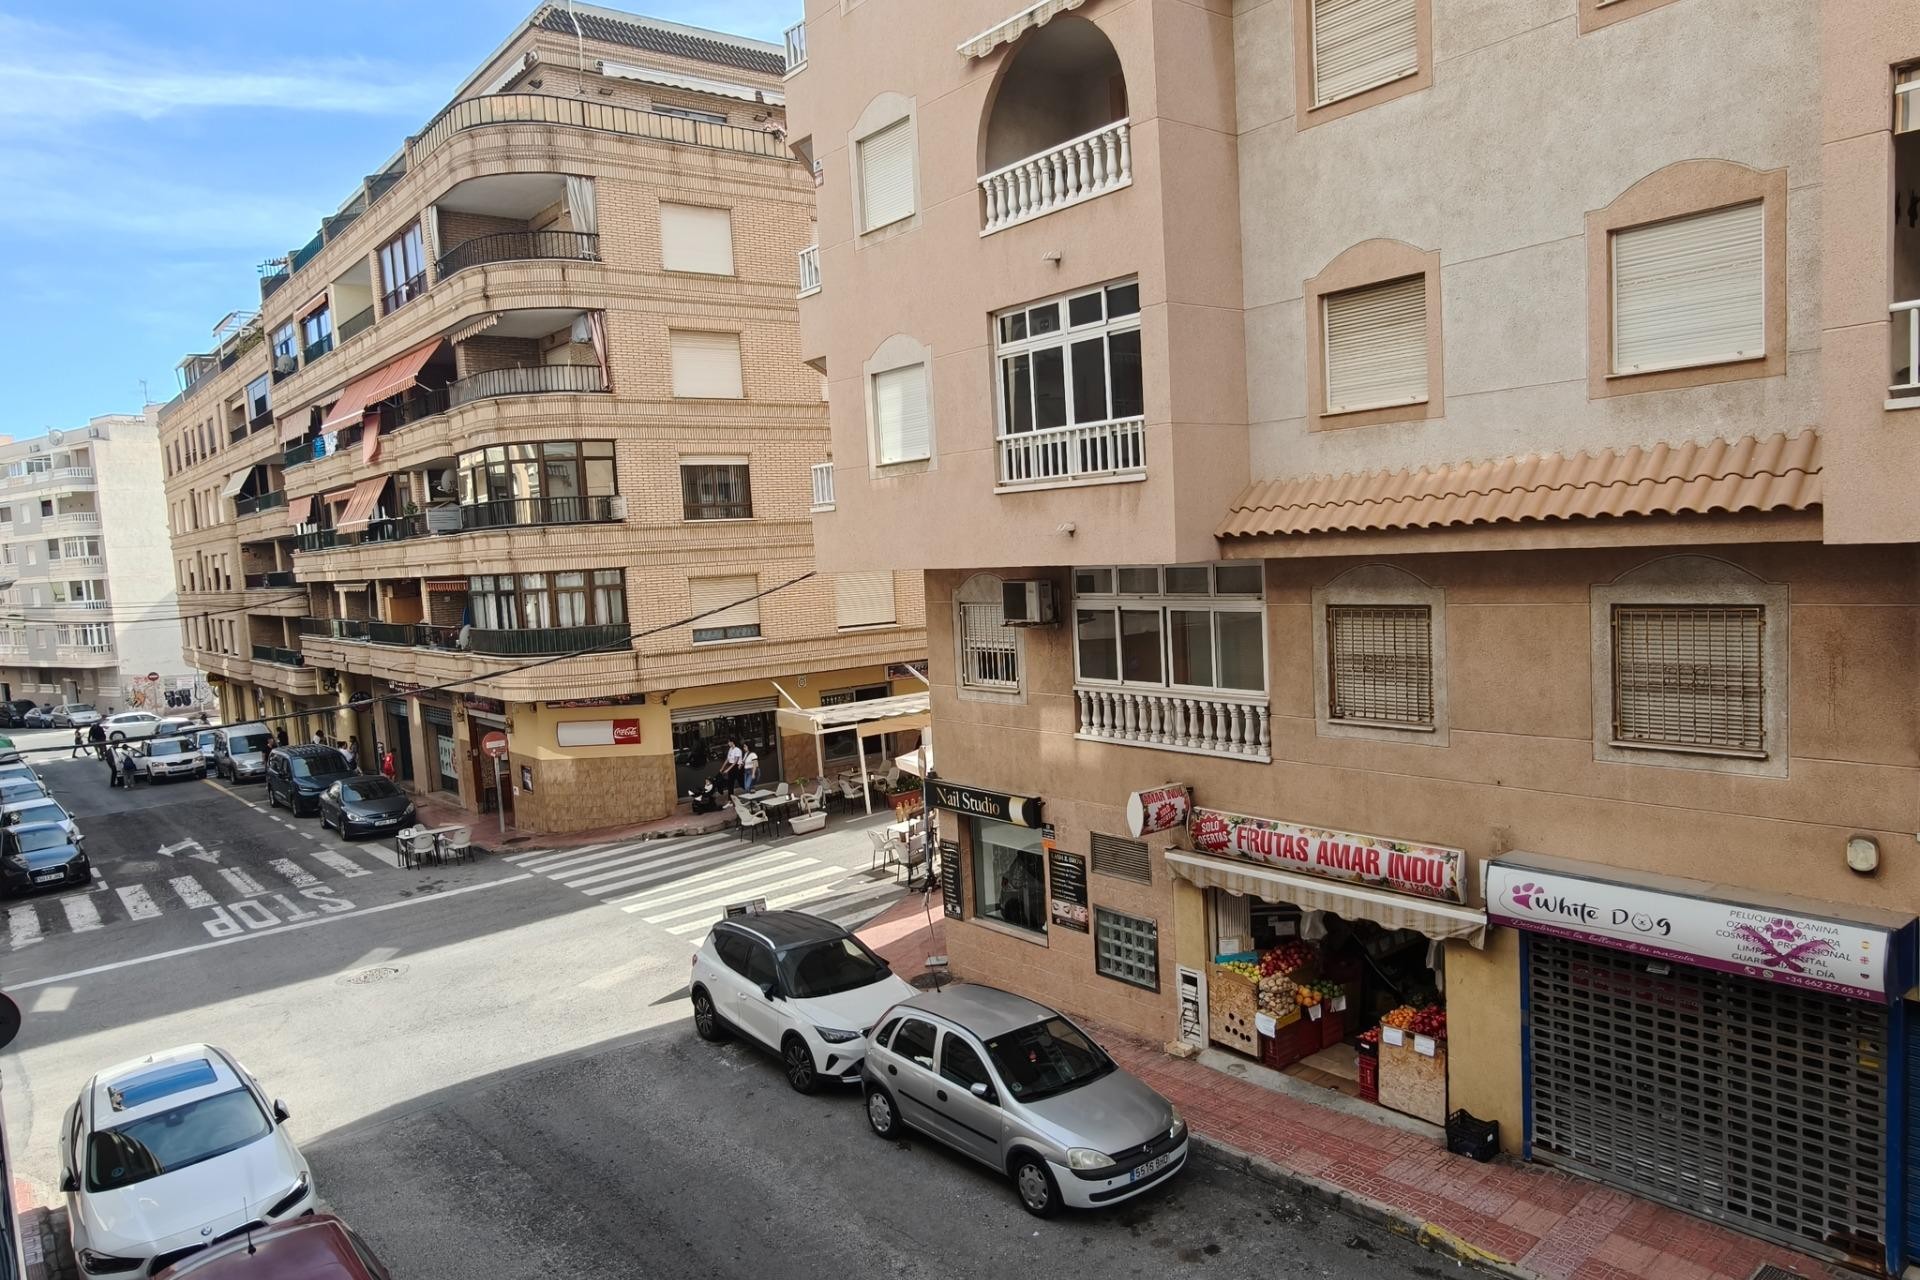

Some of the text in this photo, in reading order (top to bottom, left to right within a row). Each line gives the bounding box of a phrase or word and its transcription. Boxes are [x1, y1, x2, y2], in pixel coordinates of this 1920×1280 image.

[936, 786, 1001, 815] Nail Studio
[1143, 790, 1166, 805] AMAR
[1197, 830, 1229, 845] OFERTAS
[1200, 819, 1220, 834] SOLO
[1236, 825, 1445, 888] FRUTAS AMAR INDU
[202, 885, 357, 938] STOP
[1535, 896, 1600, 924] White
[1796, 921, 1839, 936] CANINA
[1777, 940, 1852, 962] PROSIONAL
[1816, 967, 1836, 980] DÍA
[1785, 975, 1802, 985] +34
[1805, 978, 1824, 989] 662
[1826, 981, 1839, 991] 27
[1856, 987, 1871, 998] 94
